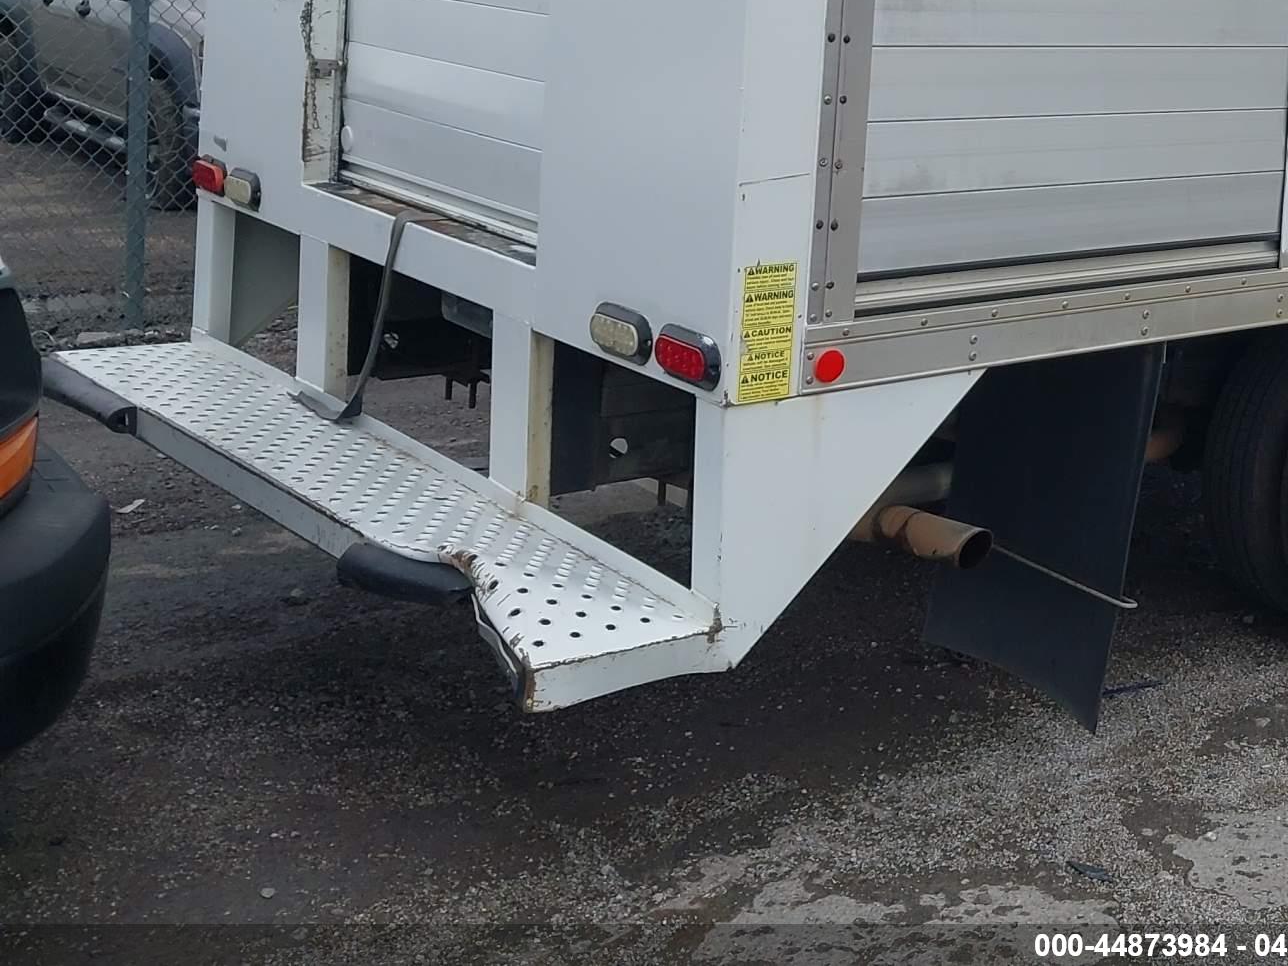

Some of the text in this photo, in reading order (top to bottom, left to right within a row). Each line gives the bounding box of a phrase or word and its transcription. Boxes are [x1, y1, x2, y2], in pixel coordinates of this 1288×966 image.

[755, 264, 795, 274] WARNING
[754, 290, 794, 301] WARNING
[751, 326, 792, 337] CAUTION
[754, 350, 785, 360] NOTICE
[750, 369, 788, 382] NOTICE
